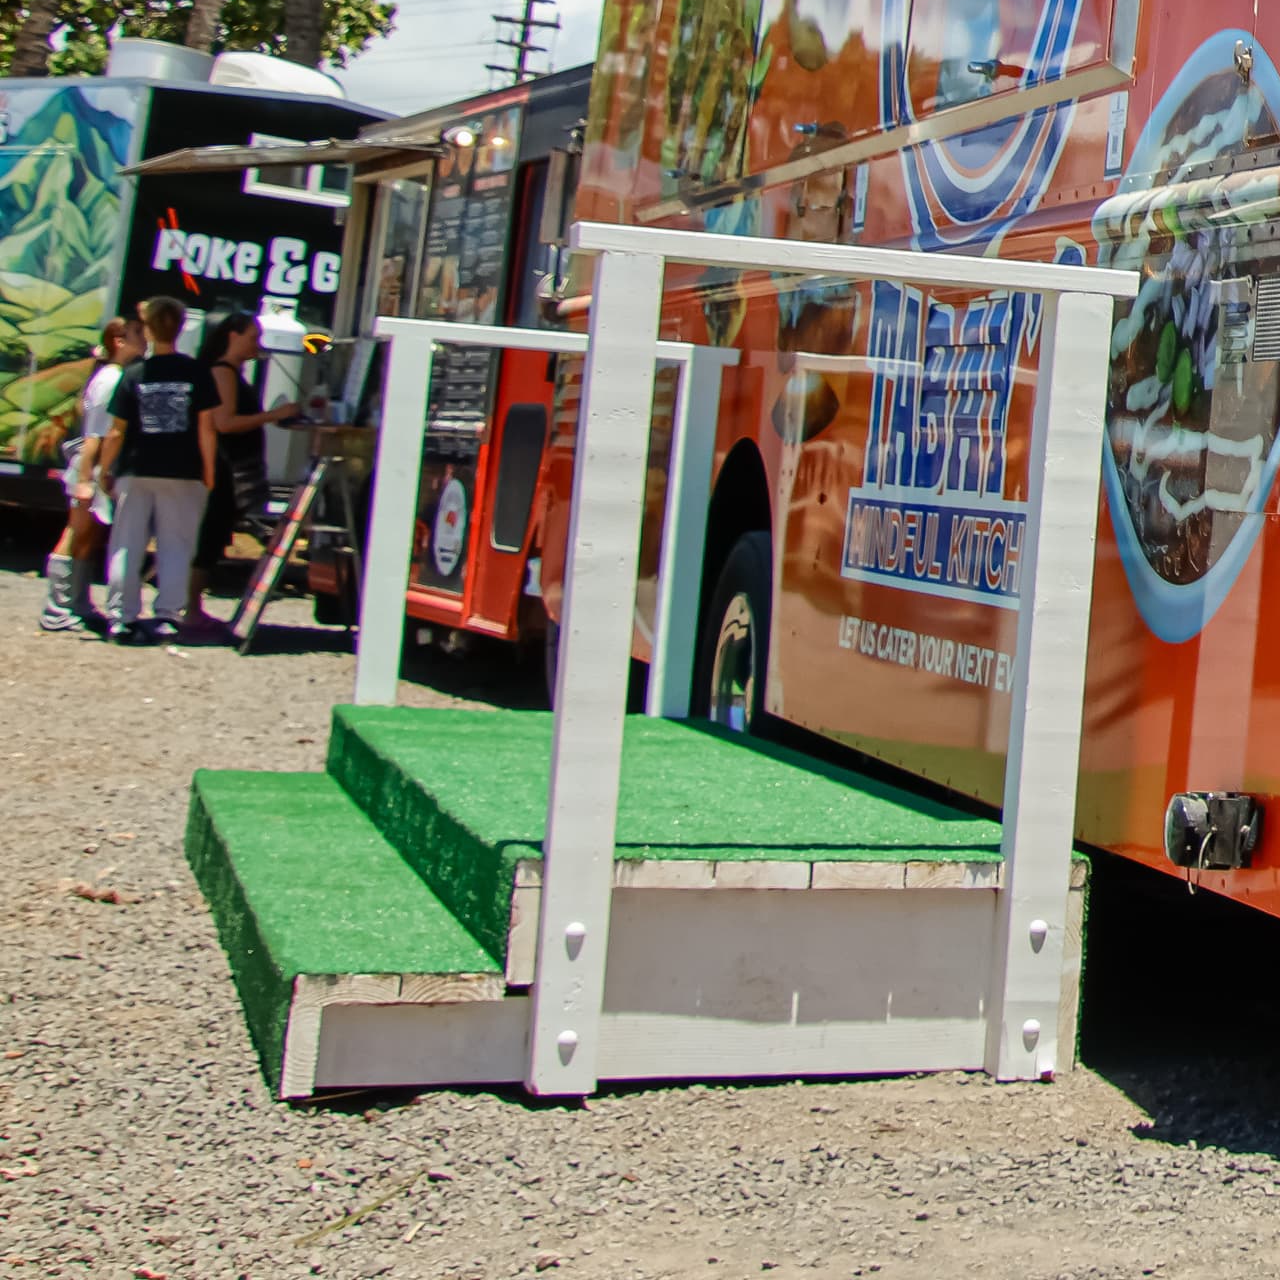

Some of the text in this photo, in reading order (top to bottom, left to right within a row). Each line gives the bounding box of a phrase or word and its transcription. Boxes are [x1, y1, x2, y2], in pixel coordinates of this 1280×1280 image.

[265, 236, 309, 295] &
[848, 504, 943, 580] MINDFUL
[839, 616, 861, 648] LET
[860, 621, 877, 654] US
[877, 624, 917, 668] CATER
[919, 634, 954, 675] YOUR
[955, 643, 993, 687] NEXT
